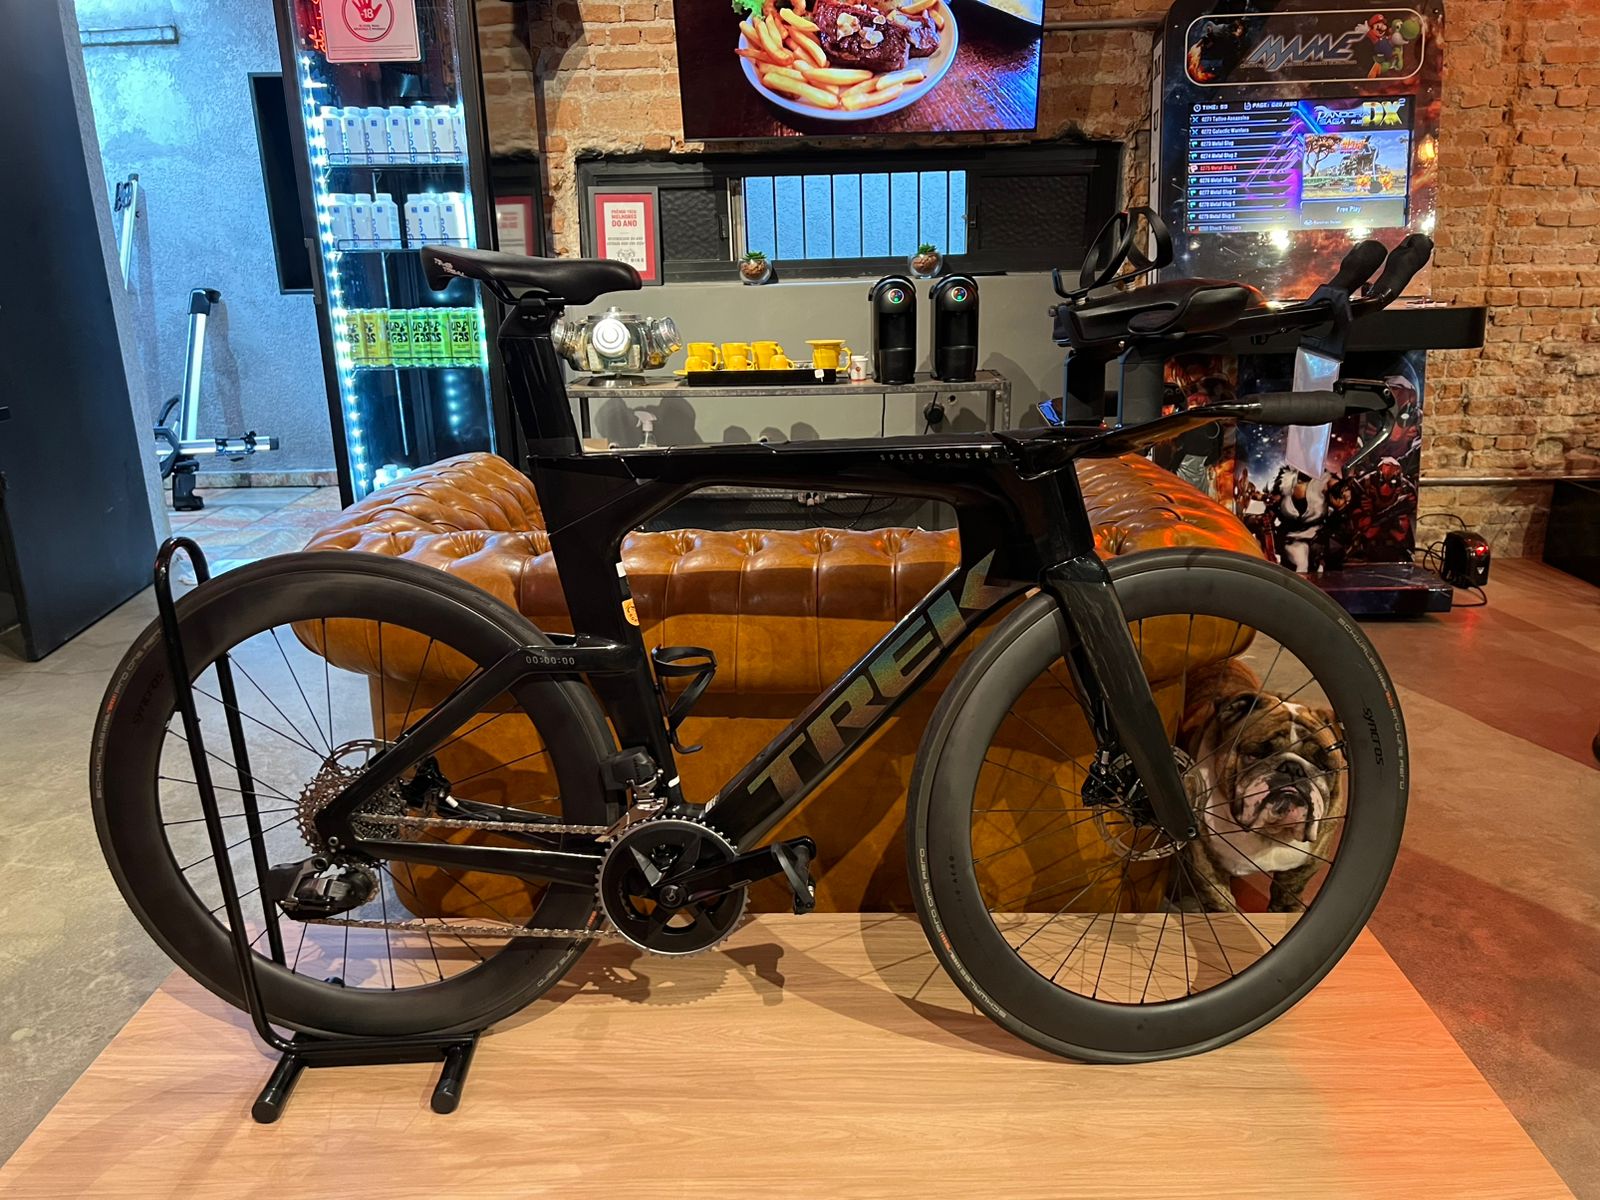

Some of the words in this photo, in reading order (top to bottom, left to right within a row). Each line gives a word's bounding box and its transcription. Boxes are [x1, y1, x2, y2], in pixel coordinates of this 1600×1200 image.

[1243, 31, 1367, 72] MAME
[1362, 101, 1403, 127] DX
[611, 220, 622, 228] DO
[623, 220, 638, 228] ANO
[934, 451, 999, 460] CONCEPT
[525, 655, 575, 665] 00:00:00
[747, 549, 1030, 802] TREK
